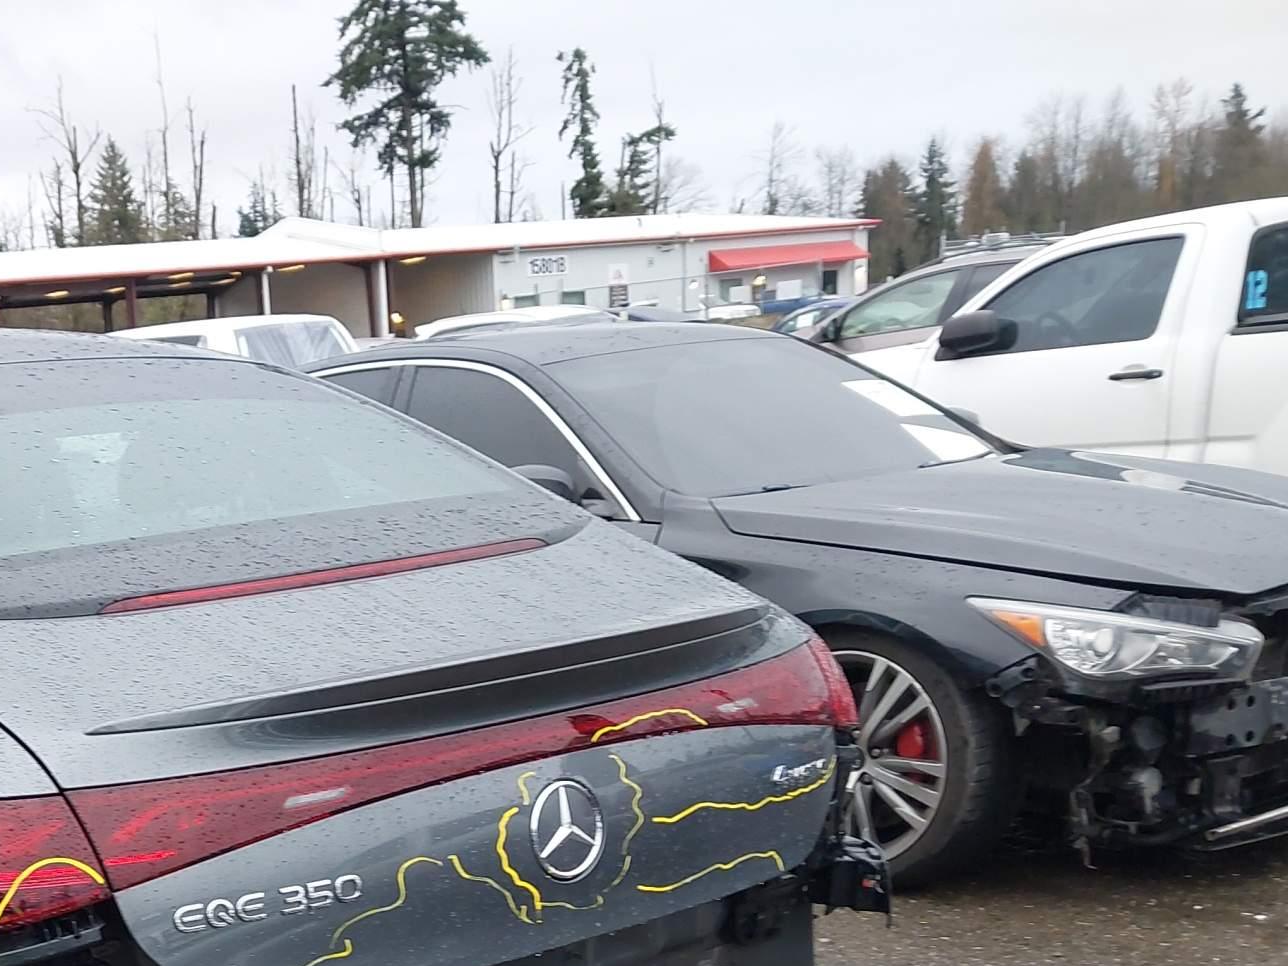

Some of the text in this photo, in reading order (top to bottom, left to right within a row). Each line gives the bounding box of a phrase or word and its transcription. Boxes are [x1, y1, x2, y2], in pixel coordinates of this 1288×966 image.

[1246, 270, 1268, 309] 12
[173, 874, 363, 933] EQE 350
